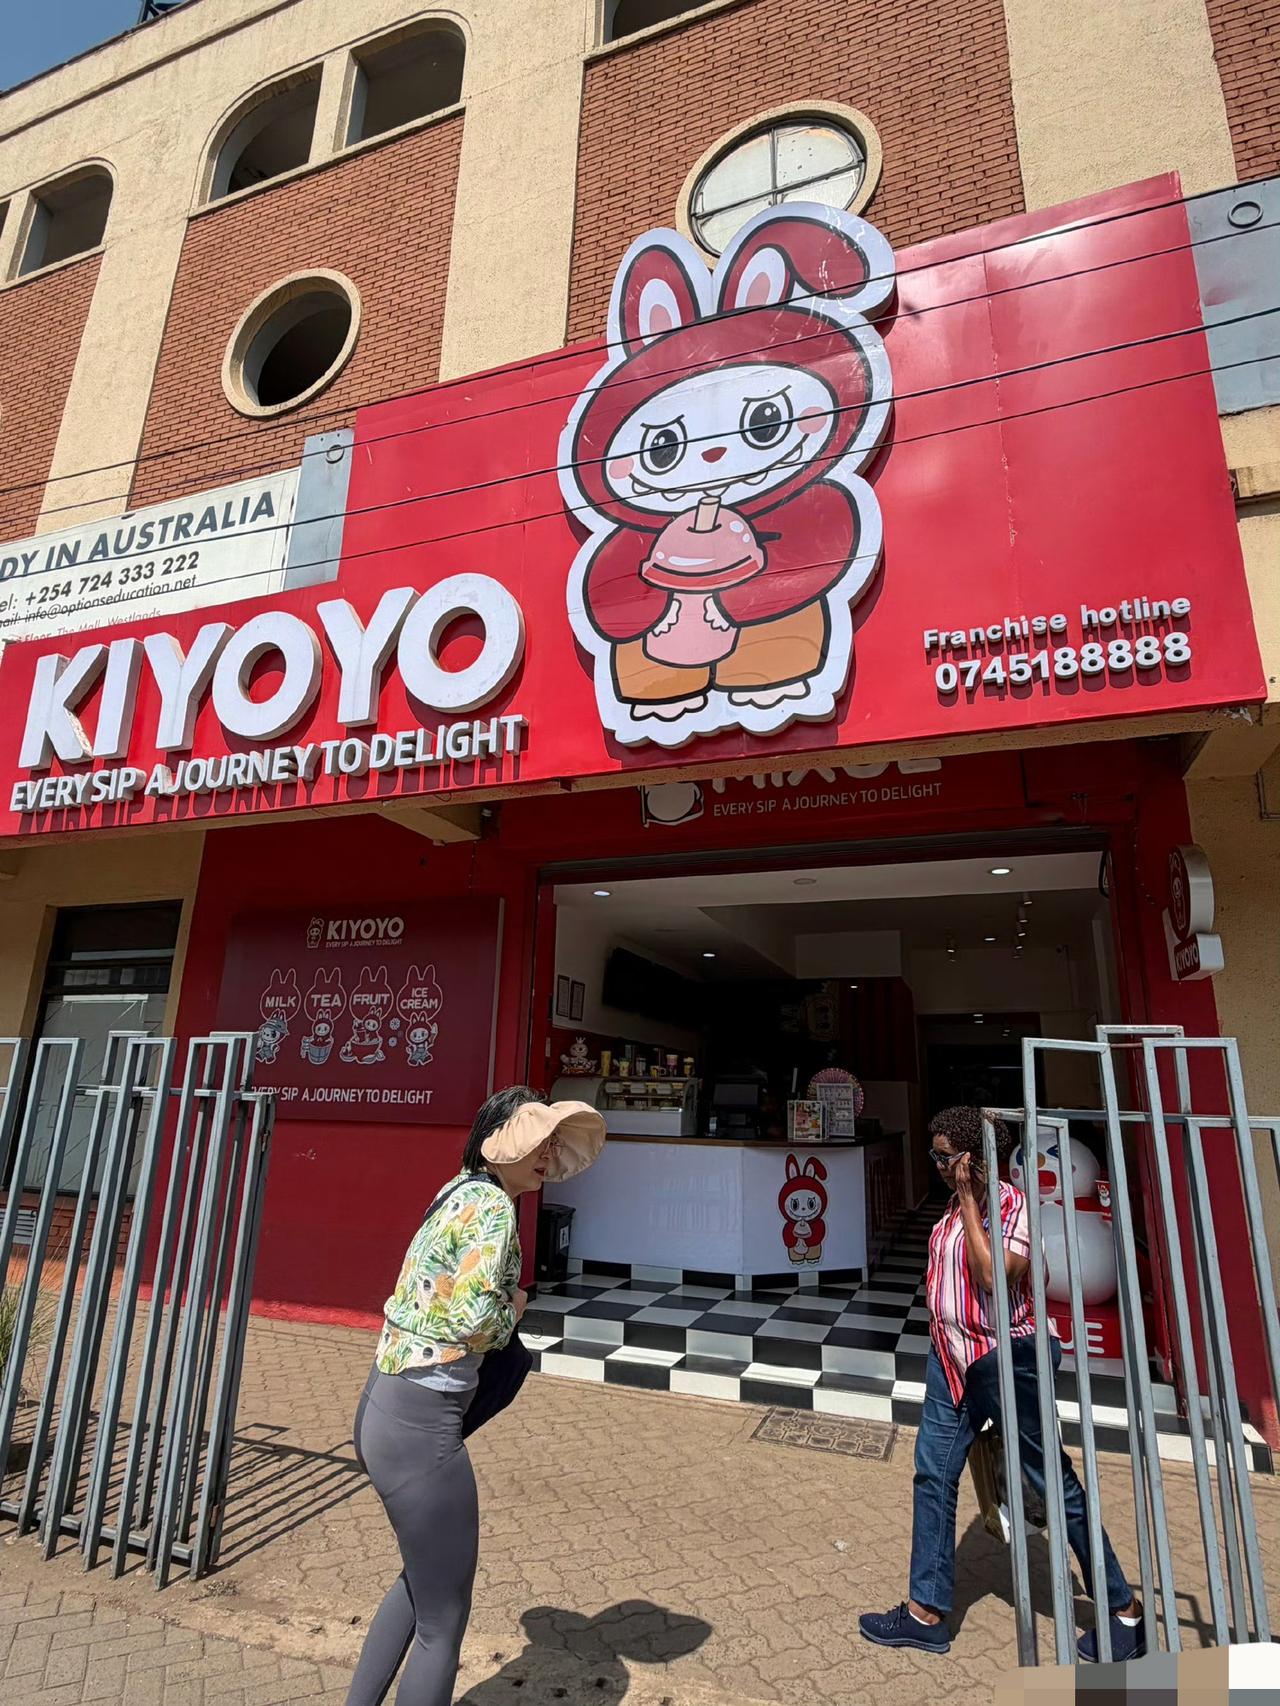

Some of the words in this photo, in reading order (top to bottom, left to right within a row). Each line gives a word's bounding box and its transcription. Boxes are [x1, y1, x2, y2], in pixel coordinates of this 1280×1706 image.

[45, 540, 82, 570] IN
[87, 491, 275, 560] AUSTRALIA
[26, 580, 72, 606] +254
[78, 571, 113, 595] 724
[118, 561, 155, 585] 333
[162, 551, 200, 576] 222
[24, 573, 197, 623] info@optionseducation.net
[924, 613, 1067, 649] Franchise
[1080, 596, 1191, 629] hotline
[18, 572, 526, 769] KIYOYO
[935, 632, 1192, 693] 0745188888
[9, 775, 94, 813] EVERY
[90, 766, 146, 803] SIP
[320, 737, 371, 777] TO
[368, 714, 529, 770] DELIGHT
[713, 802, 754, 817] EVERY
[757, 799, 778, 814] SIP
[859, 789, 878, 803] TO
[881, 782, 943, 802] DELIGHT
[326, 916, 405, 940] KIYOYO
[265, 995, 296, 1008] MILK
[311, 994, 342, 1008] TEA
[353, 993, 390, 1006] FRUIT
[400, 998, 438, 1009] CREAM
[411, 987, 428, 998] ICE
[280, 1086, 299, 1101] SIP
[365, 1088, 380, 1103] TO
[382, 1089, 433, 1105] DELIGHT
